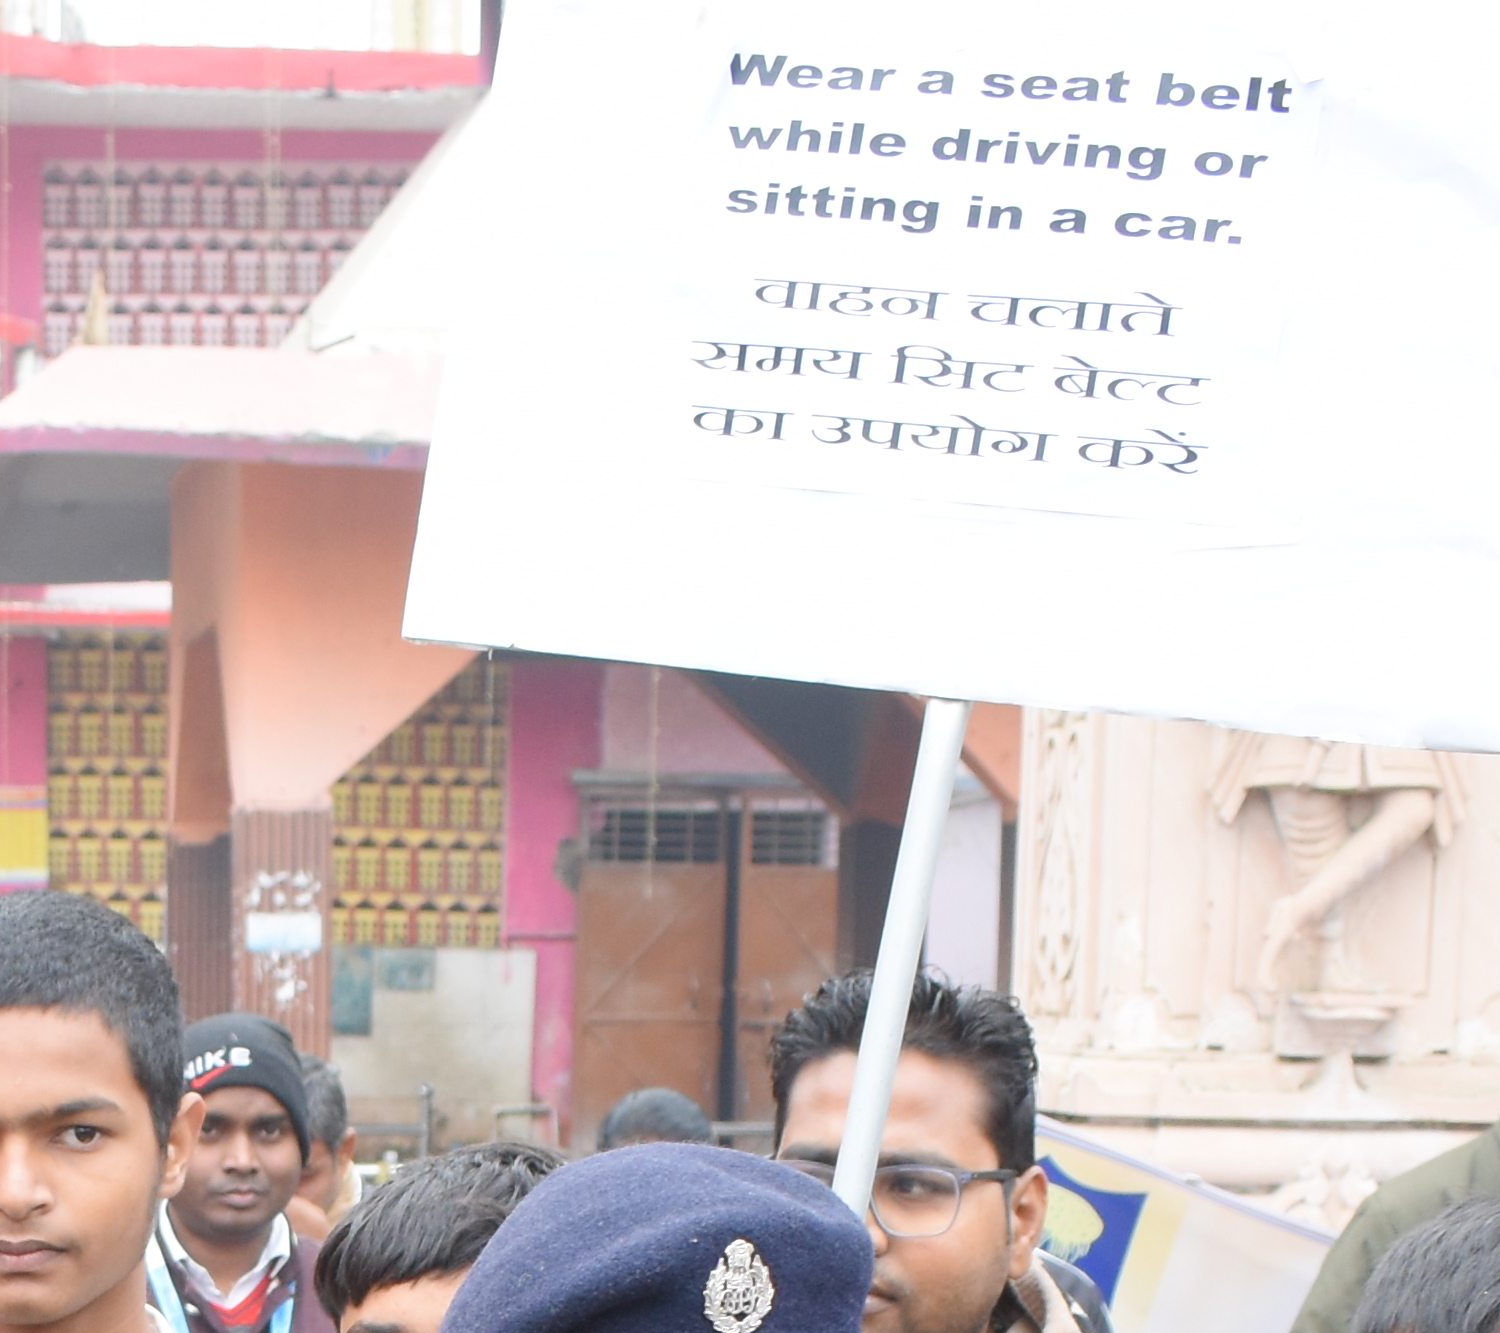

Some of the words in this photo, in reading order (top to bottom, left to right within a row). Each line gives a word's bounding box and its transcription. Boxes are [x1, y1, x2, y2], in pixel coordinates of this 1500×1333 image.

[729, 49, 897, 97] Wear
[917, 71, 955, 96] a
[981, 69, 1131, 104] seat
[1156, 70, 1293, 114] belt
[729, 119, 908, 158] while
[931, 127, 1168, 182] driving
[1194, 150, 1269, 179] or
[725, 182, 941, 234] sitting
[966, 195, 1024, 231] in
[1049, 207, 1088, 235] a
[1114, 210, 1243, 246] car.
[754, 277, 950, 322] वाहन
[967, 290, 1184, 338] चलाते
[690, 340, 873, 381] समय
[889, 343, 1036, 394] सिट
[1052, 354, 1212, 407] बेल्ट
[691, 404, 796, 442] का
[811, 414, 1060, 464] उपयोग
[1077, 428, 1210, 475] करें
[183, 1045, 253, 1080] NIKE
